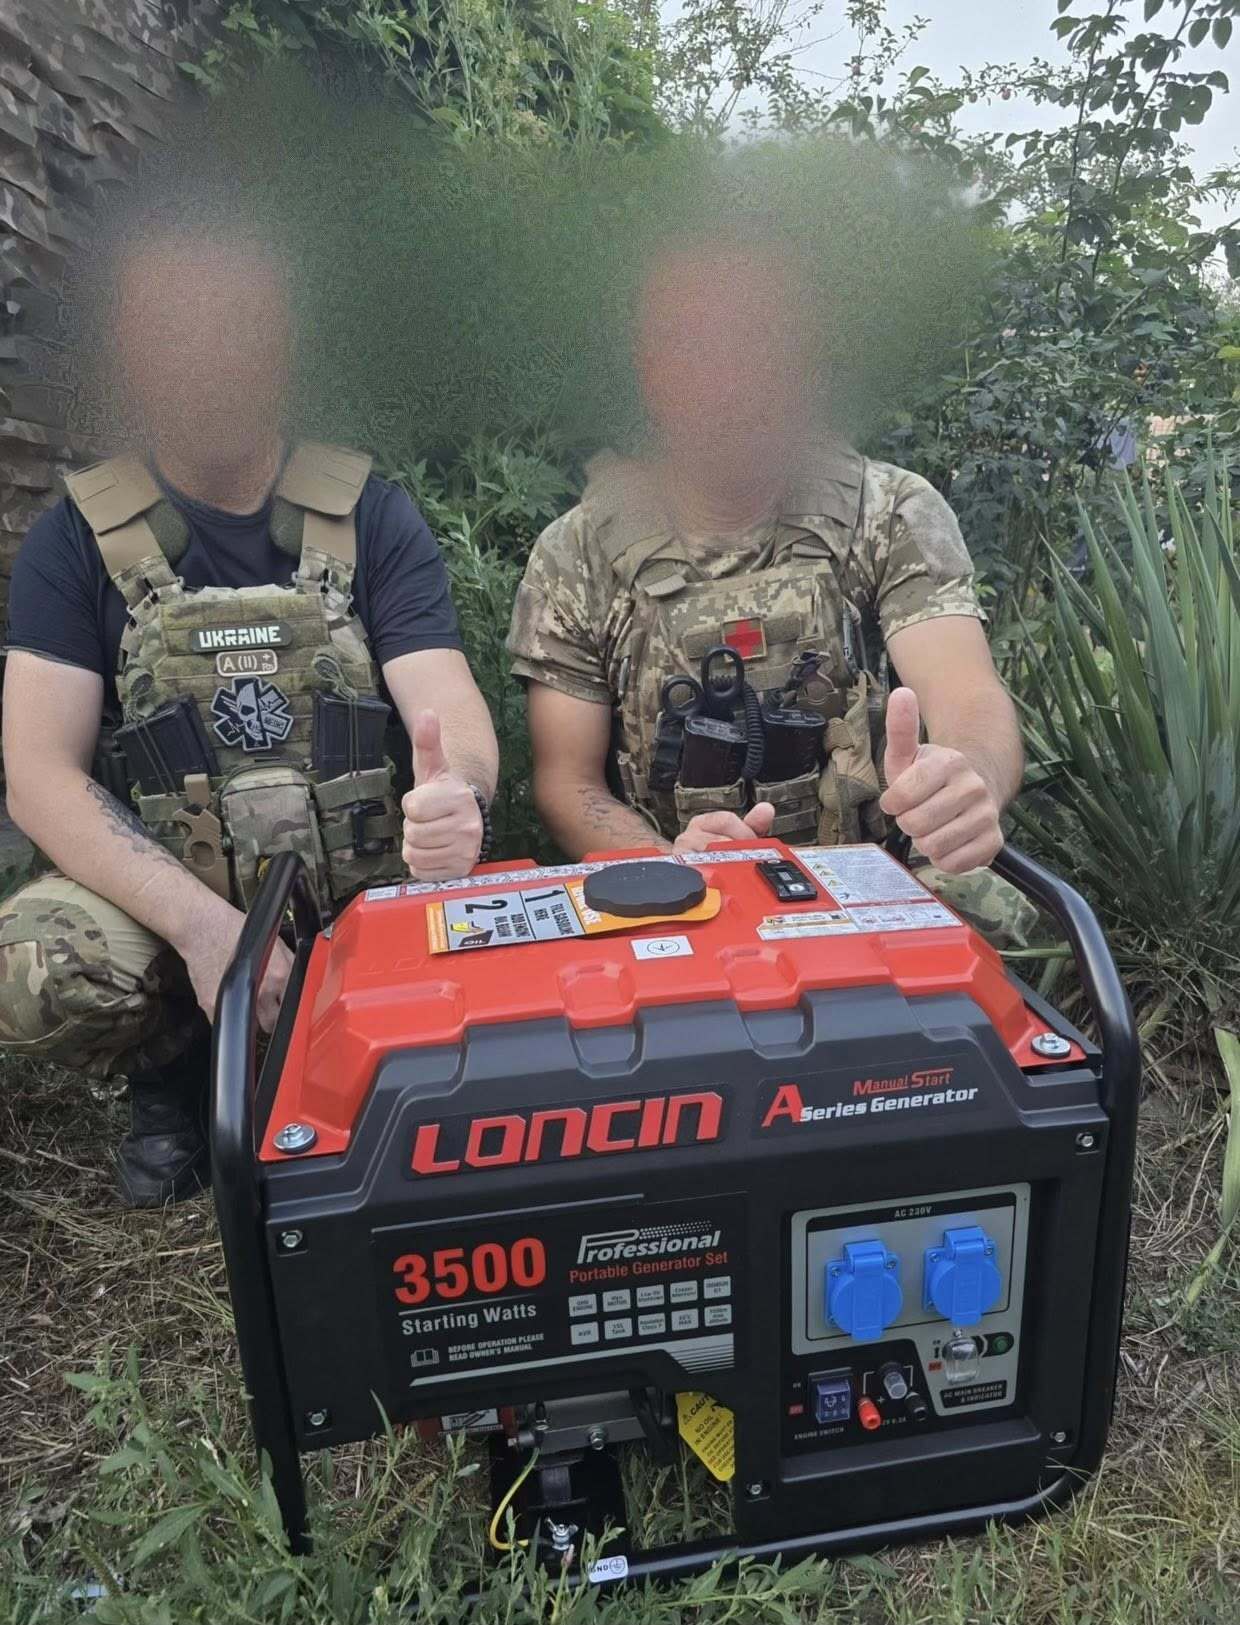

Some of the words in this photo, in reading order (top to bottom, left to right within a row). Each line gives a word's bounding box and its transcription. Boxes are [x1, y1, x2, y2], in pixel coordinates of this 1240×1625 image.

[199, 626, 281, 648] UKRAINE
[223, 657, 236, 671] A
[465, 900, 508, 914] 2
[525, 889, 565, 902] 1
[853, 1079, 908, 1096] Manual
[911, 1068, 954, 1088] Start
[761, 1084, 804, 1127] A
[800, 1102, 867, 1122] Series
[870, 1088, 978, 1112] Generator
[411, 1091, 723, 1174] LONCIN
[895, 1209, 906, 1218] AC
[577, 1229, 721, 1264] Professional
[392, 1237, 546, 1305] 3500
[569, 1264, 628, 1283] Portable
[632, 1255, 701, 1275] Generator
[705, 1252, 728, 1265] Set
[402, 1313, 479, 1336] Starting
[483, 1303, 537, 1324] Watts
[448, 1343, 476, 1354] BEFORE
[477, 1337, 517, 1349] OPERATION
[518, 1333, 545, 1344] PLEASE
[449, 1353, 468, 1361] READ
[503, 1344, 532, 1354] MANUAL
